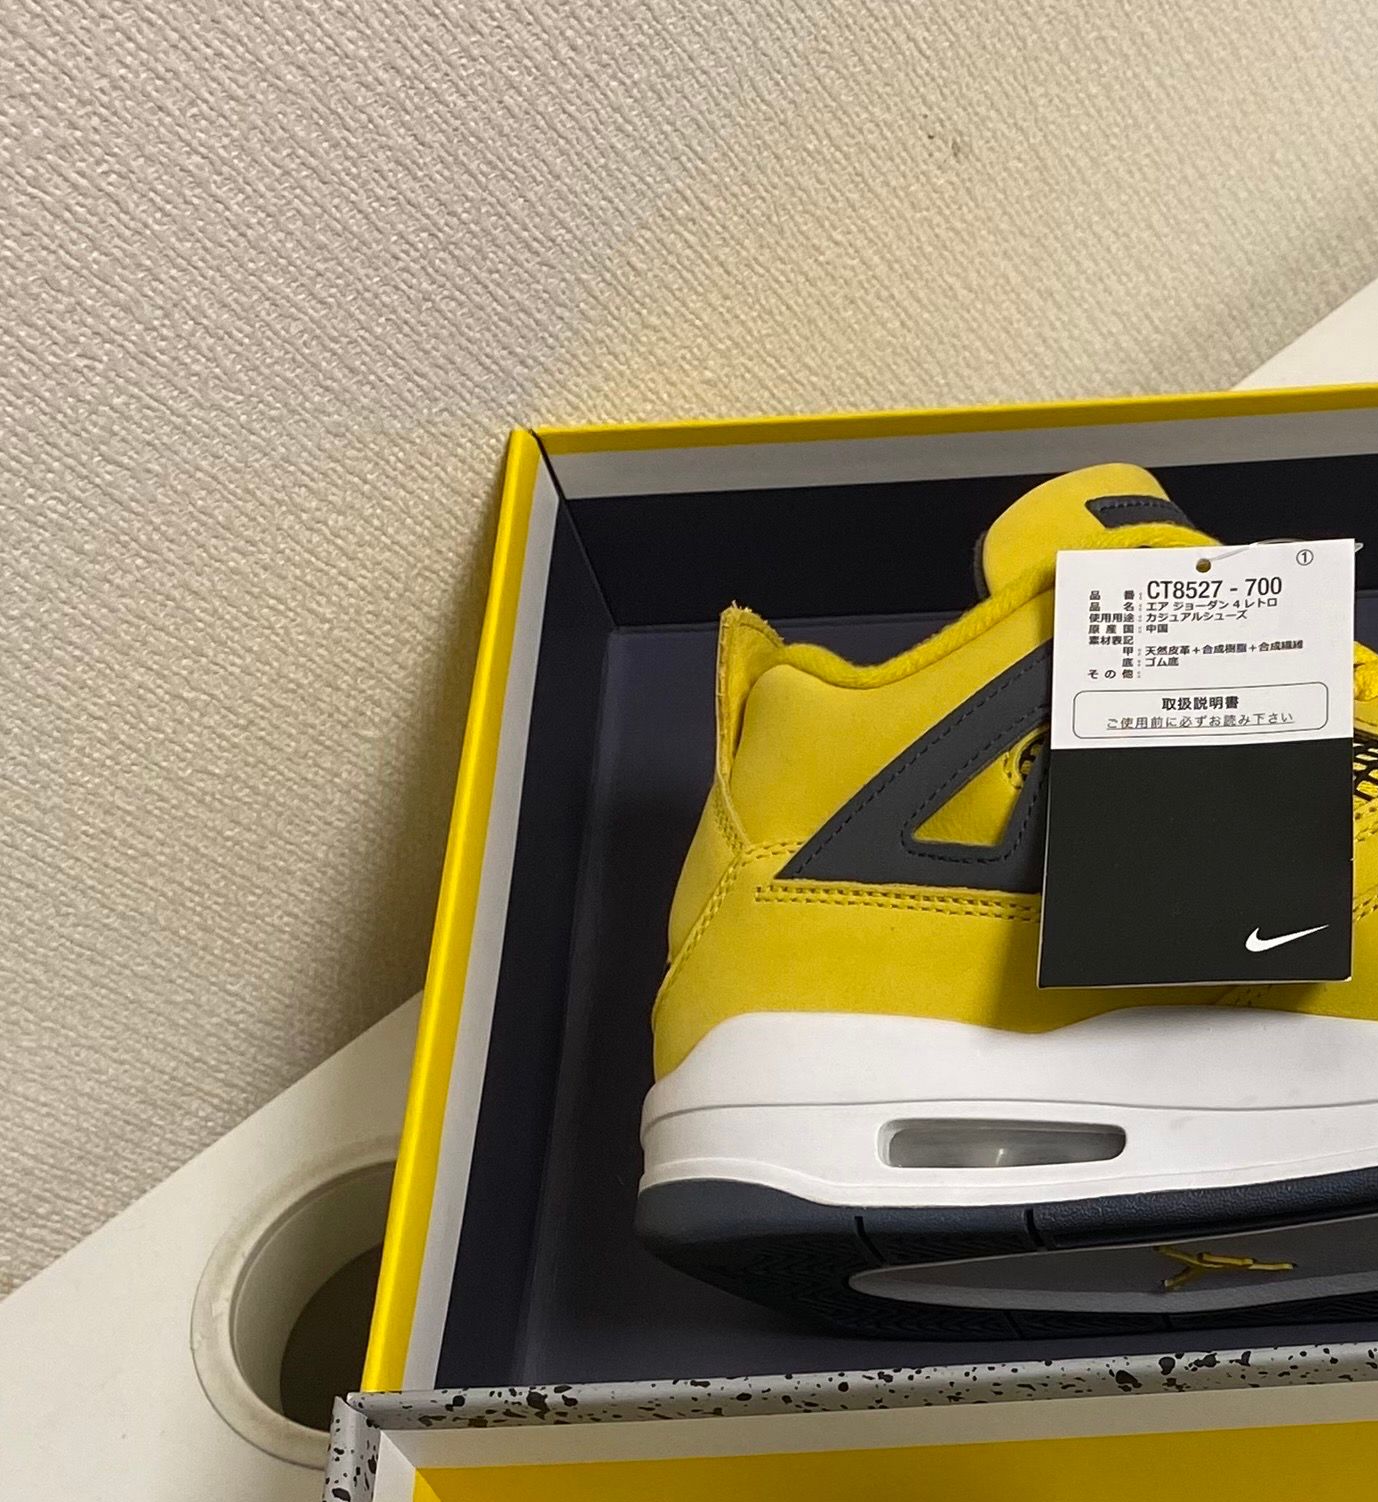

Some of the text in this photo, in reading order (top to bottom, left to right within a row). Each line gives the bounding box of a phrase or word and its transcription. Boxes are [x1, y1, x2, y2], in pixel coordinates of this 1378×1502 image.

[1147, 579, 1223, 599] CT8527
[1244, 576, 1283, 597] 700
[1161, 695, 1240, 711] 取扱説明書
[1106, 711, 1294, 729] ご使用前に必ずお読み下さい
